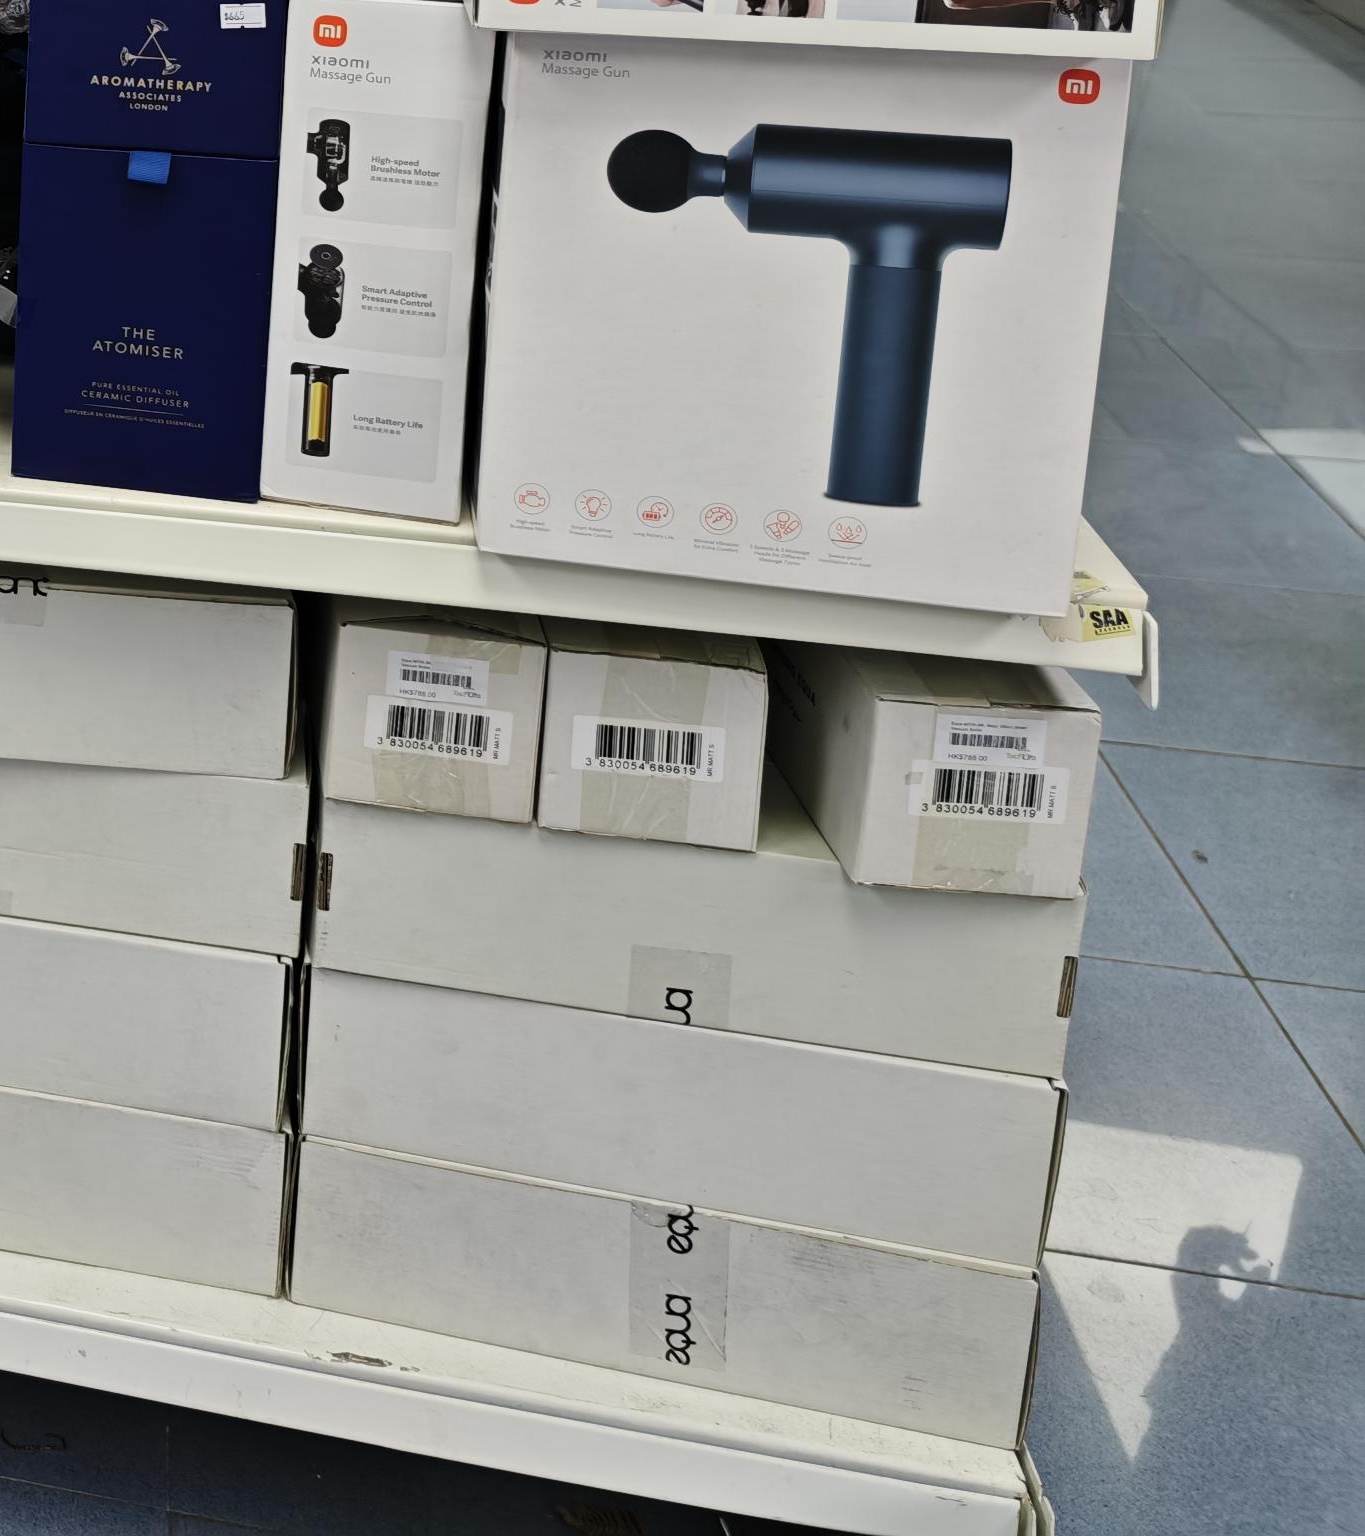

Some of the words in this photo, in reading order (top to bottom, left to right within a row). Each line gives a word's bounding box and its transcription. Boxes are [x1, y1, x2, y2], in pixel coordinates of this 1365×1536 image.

[311, 55, 371, 70] xiaomi
[543, 49, 608, 64] xiaomi
[309, 68, 363, 83] Massage
[366, 72, 392, 85] Gun
[541, 62, 596, 79] Massage
[600, 65, 631, 80] Gun
[90, 74, 213, 93] AROMATHERAPY
[119, 91, 182, 103] ASSOCIATES
[129, 103, 169, 112] LONDON
[371, 156, 419, 167] High-speed
[371, 165, 412, 176] Brushless
[413, 168, 440, 178] Motor
[362, 285, 388, 295] Smart
[389, 289, 428, 299] Adaptive
[362, 294, 398, 305] Pressure
[399, 298, 432, 308] Control
[121, 326, 156, 341] THE
[92, 340, 184, 361] ATOMISER
[81, 390, 131, 402] CERAMIC
[136, 396, 189, 408] DIFFUSER
[353, 414, 374, 424] Long
[375, 416, 406, 429] Battery
[407, 421, 423, 429] Life
[1089, 609, 1129, 629] SAA
[921, 803, 928, 812] 3
[935, 803, 983, 815] 830054
[988, 807, 1036, 817] 689619
